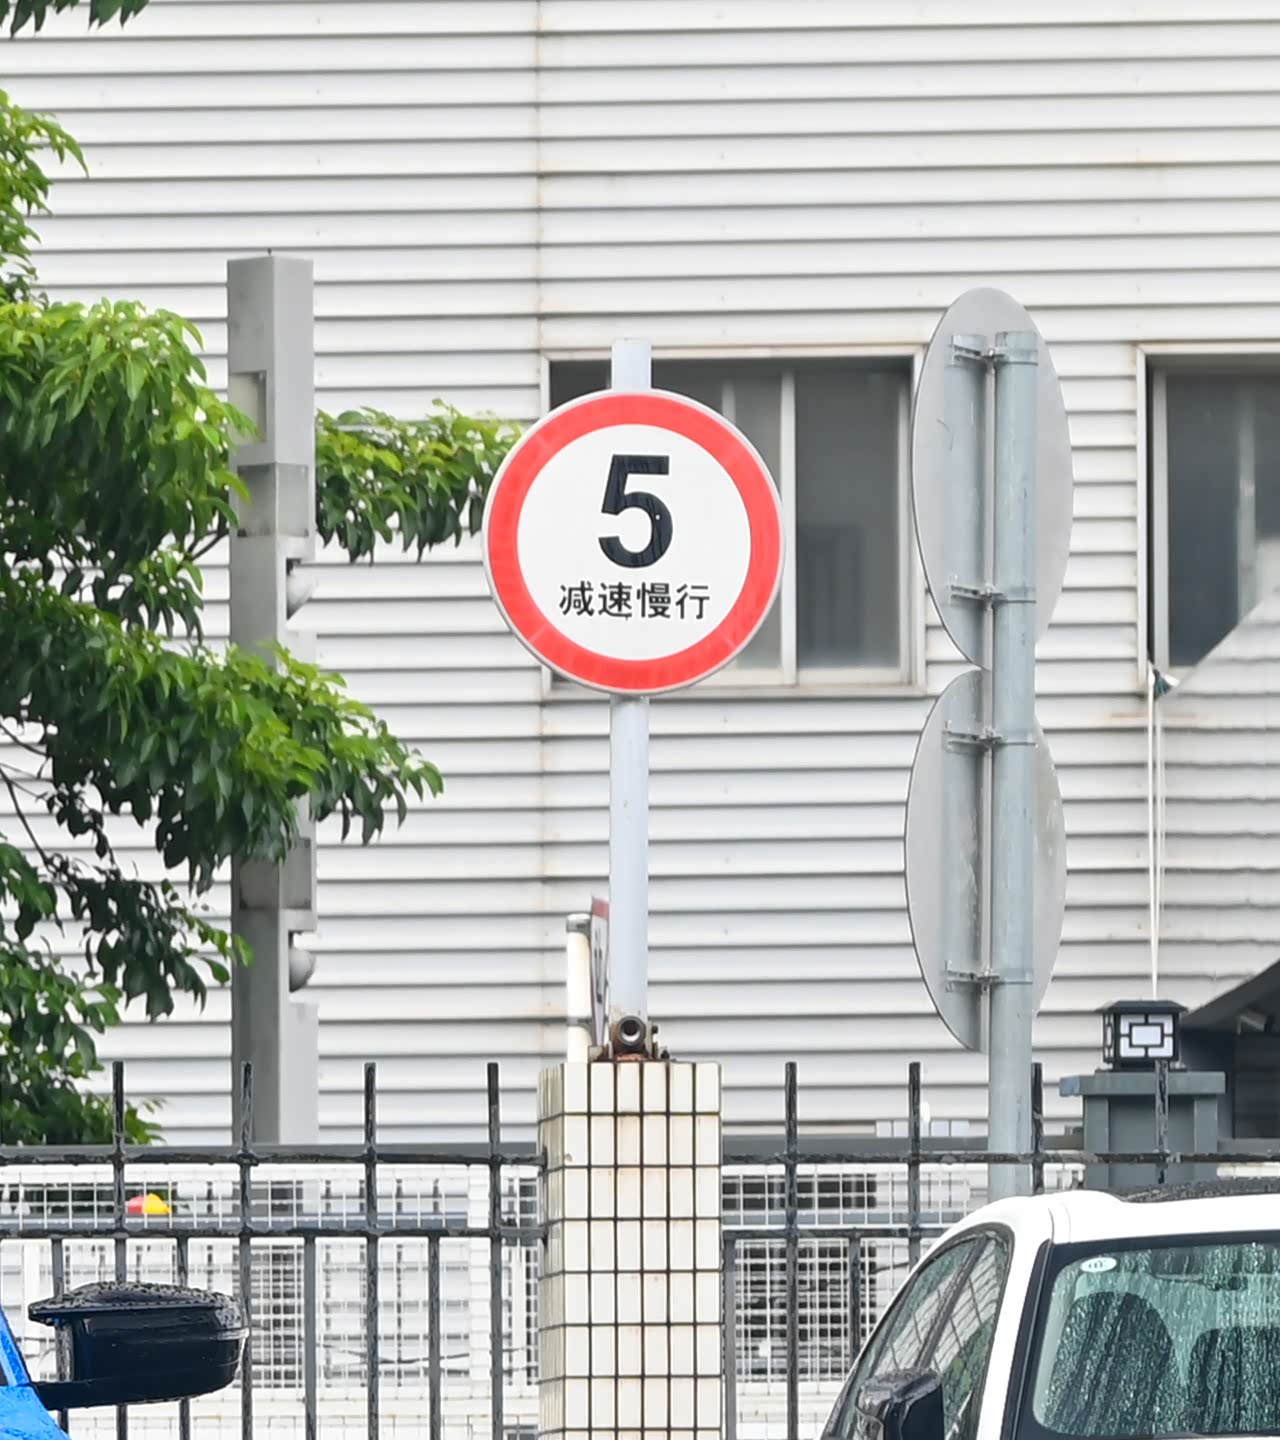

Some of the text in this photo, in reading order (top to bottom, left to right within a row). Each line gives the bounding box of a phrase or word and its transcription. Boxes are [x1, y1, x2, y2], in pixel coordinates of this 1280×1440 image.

[598, 454, 673, 568] 5
[559, 580, 710, 620] 减速慢行
